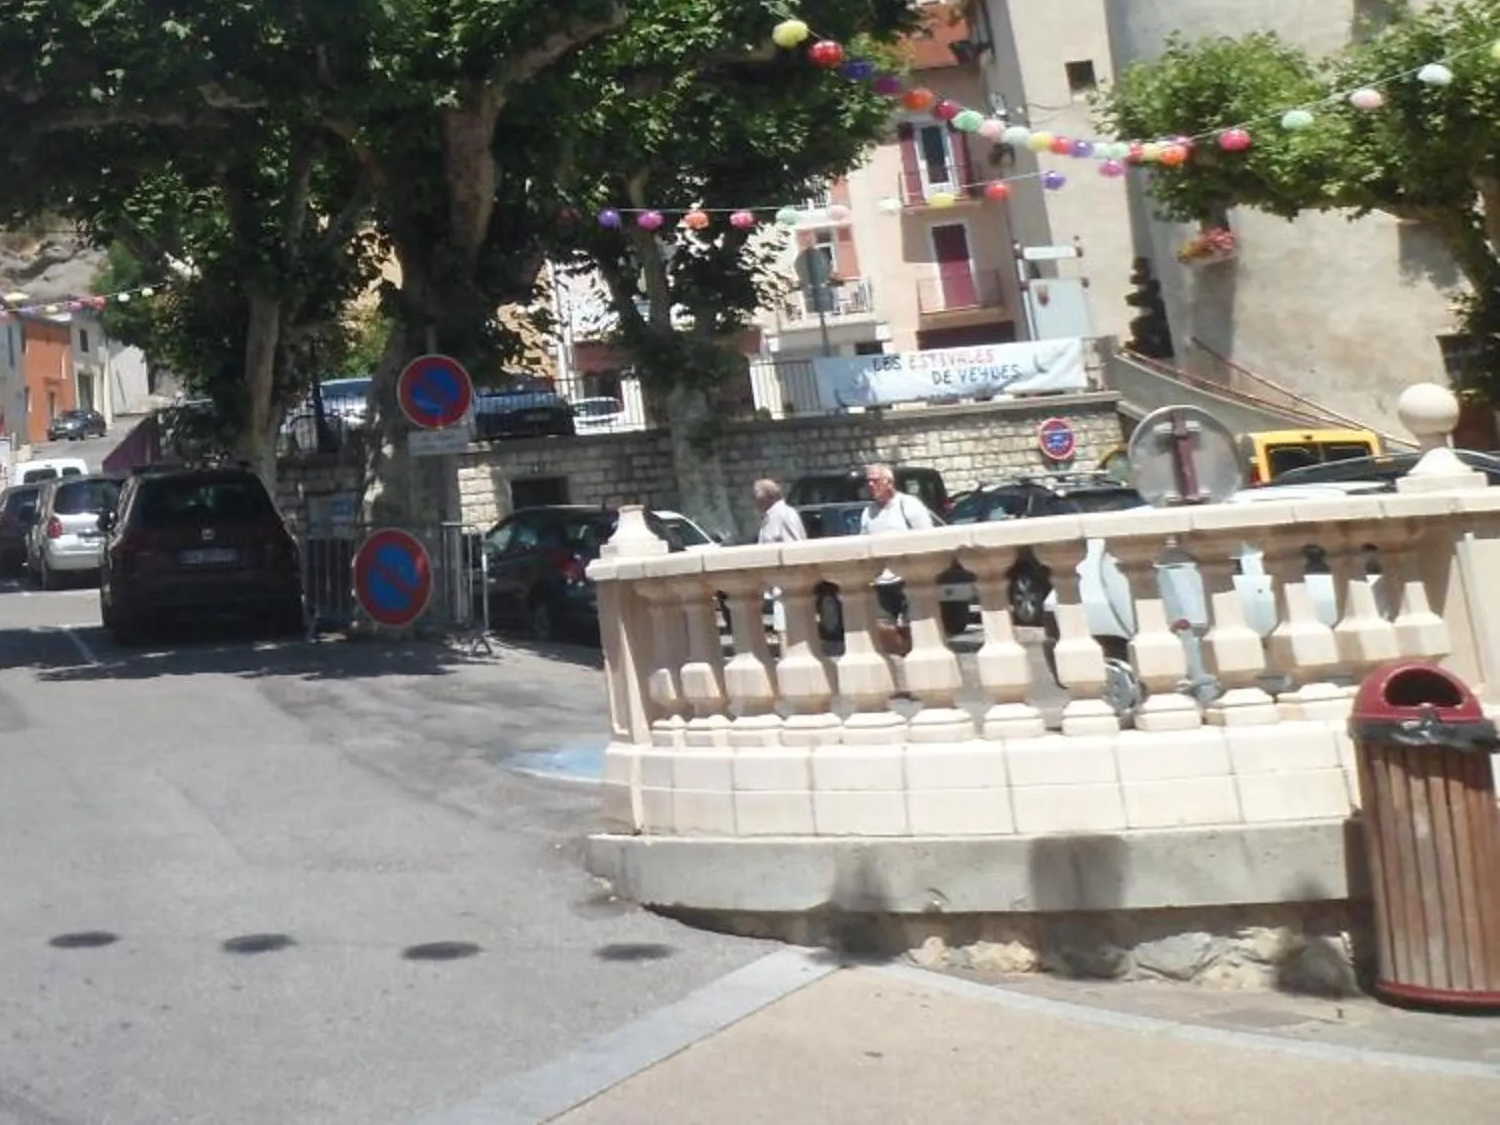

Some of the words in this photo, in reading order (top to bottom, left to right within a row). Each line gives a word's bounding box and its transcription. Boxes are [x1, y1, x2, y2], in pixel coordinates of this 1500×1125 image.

[872, 355, 902, 372] LES
[909, 347, 996, 370] ESTIVALES
[931, 370, 953, 385] DE
